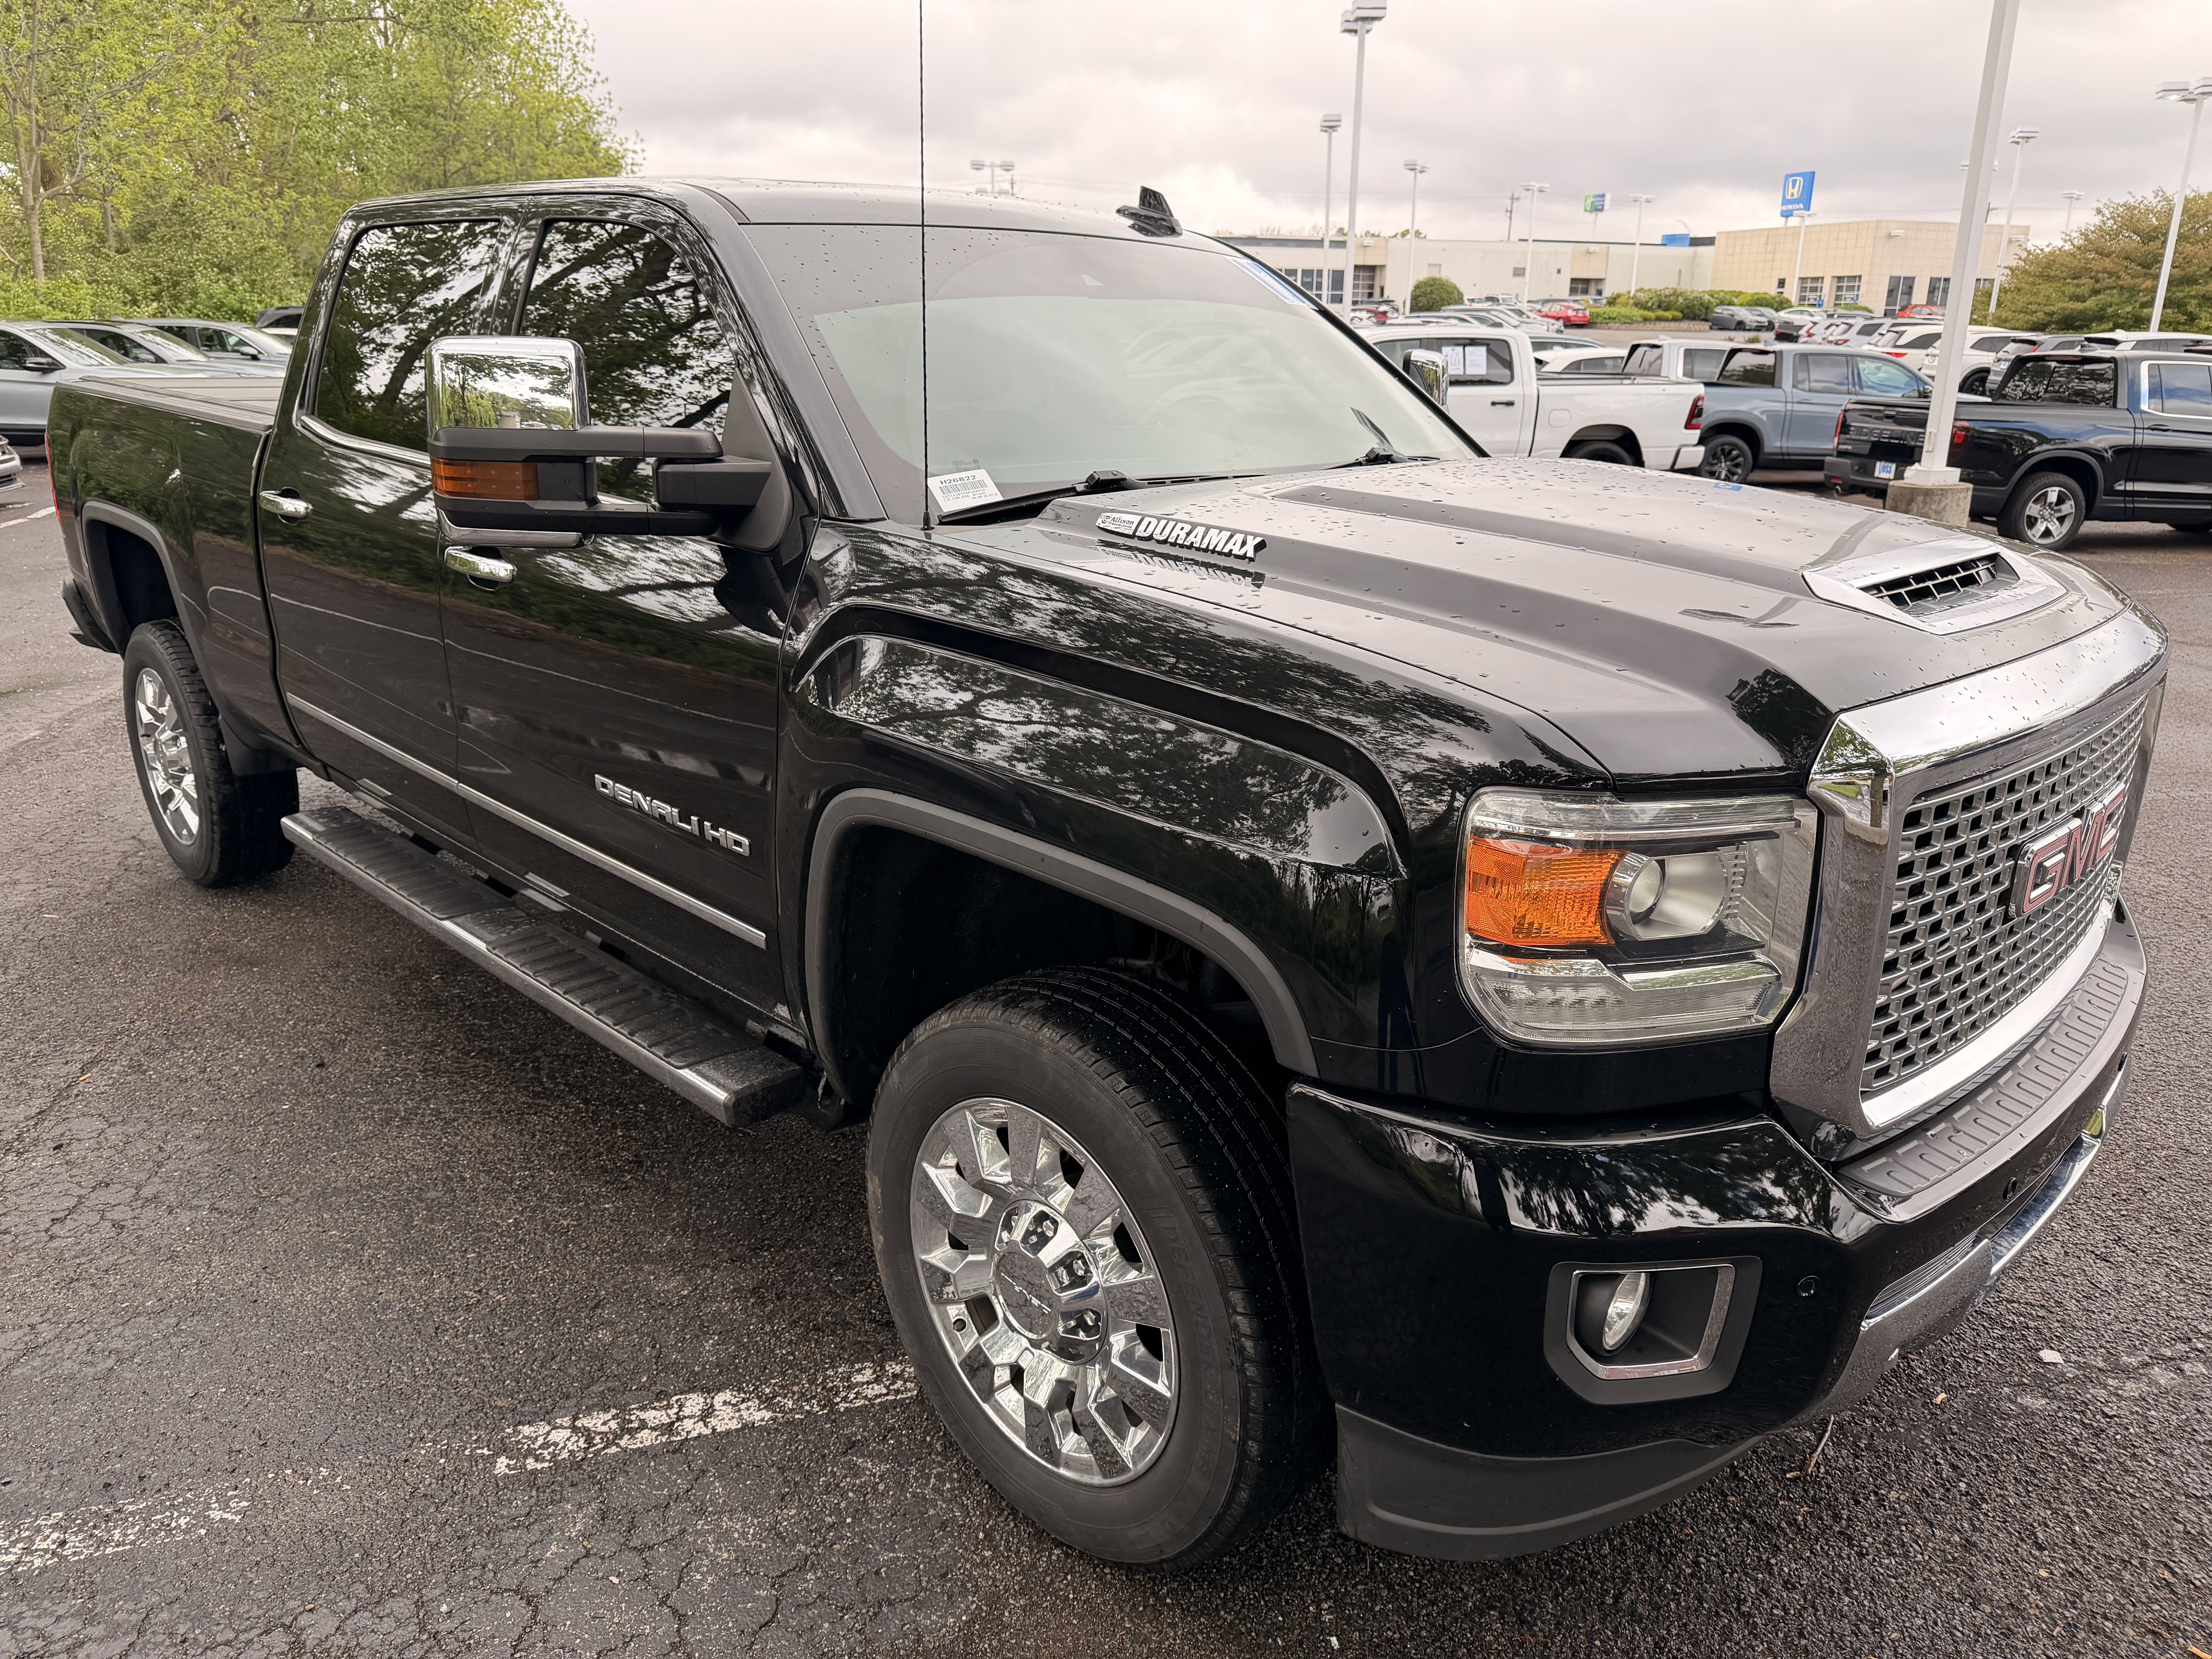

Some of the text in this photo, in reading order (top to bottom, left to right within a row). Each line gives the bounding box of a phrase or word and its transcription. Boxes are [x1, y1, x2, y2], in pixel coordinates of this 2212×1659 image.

[940, 475, 977, 485] H26822
[1110, 517, 1134, 525] Allison
[1135, 516, 1265, 559] DURAMAX
[594, 774, 751, 857] DENALI HD
[2021, 781, 2126, 915] GMC
